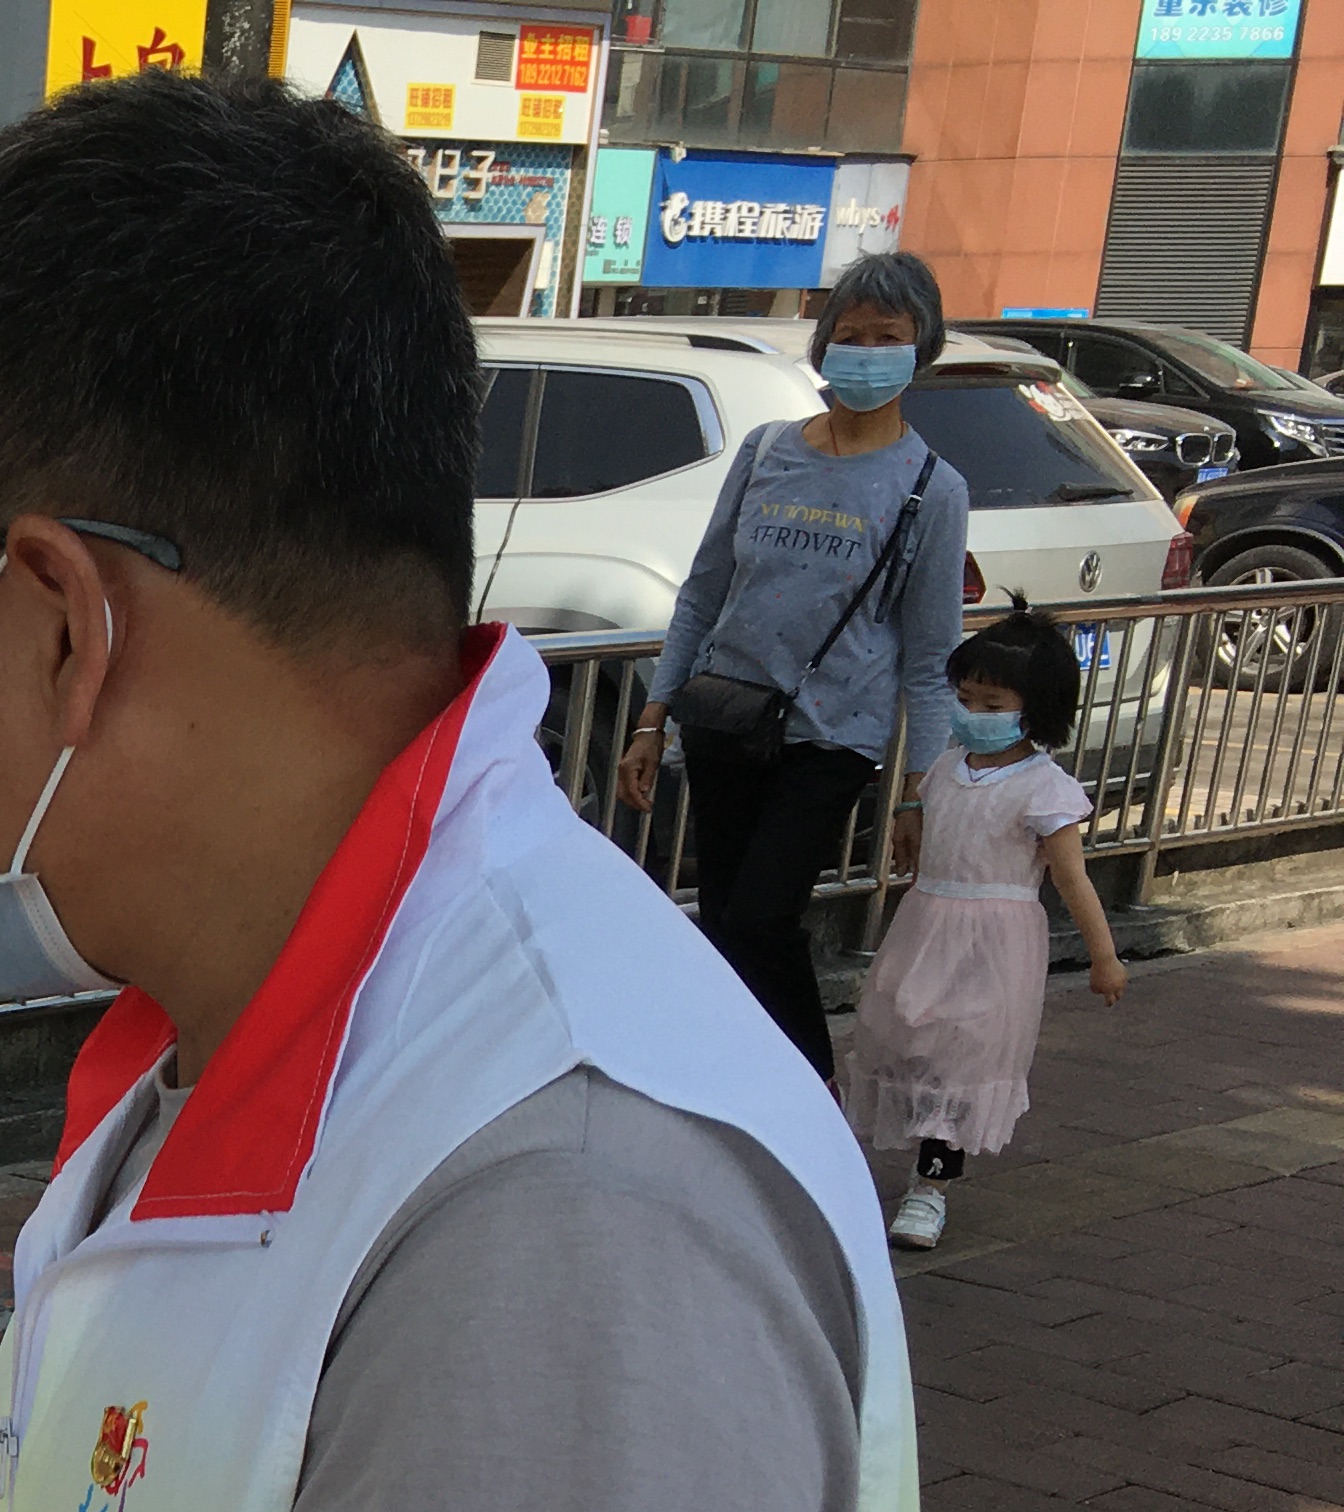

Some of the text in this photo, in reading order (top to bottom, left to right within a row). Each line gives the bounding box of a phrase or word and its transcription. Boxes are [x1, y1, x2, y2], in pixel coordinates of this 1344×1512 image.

[521, 33, 589, 62] 业主招租
[1151, 26, 1285, 42] 189 2235 7866
[687, 200, 827, 240] 携程旅游
